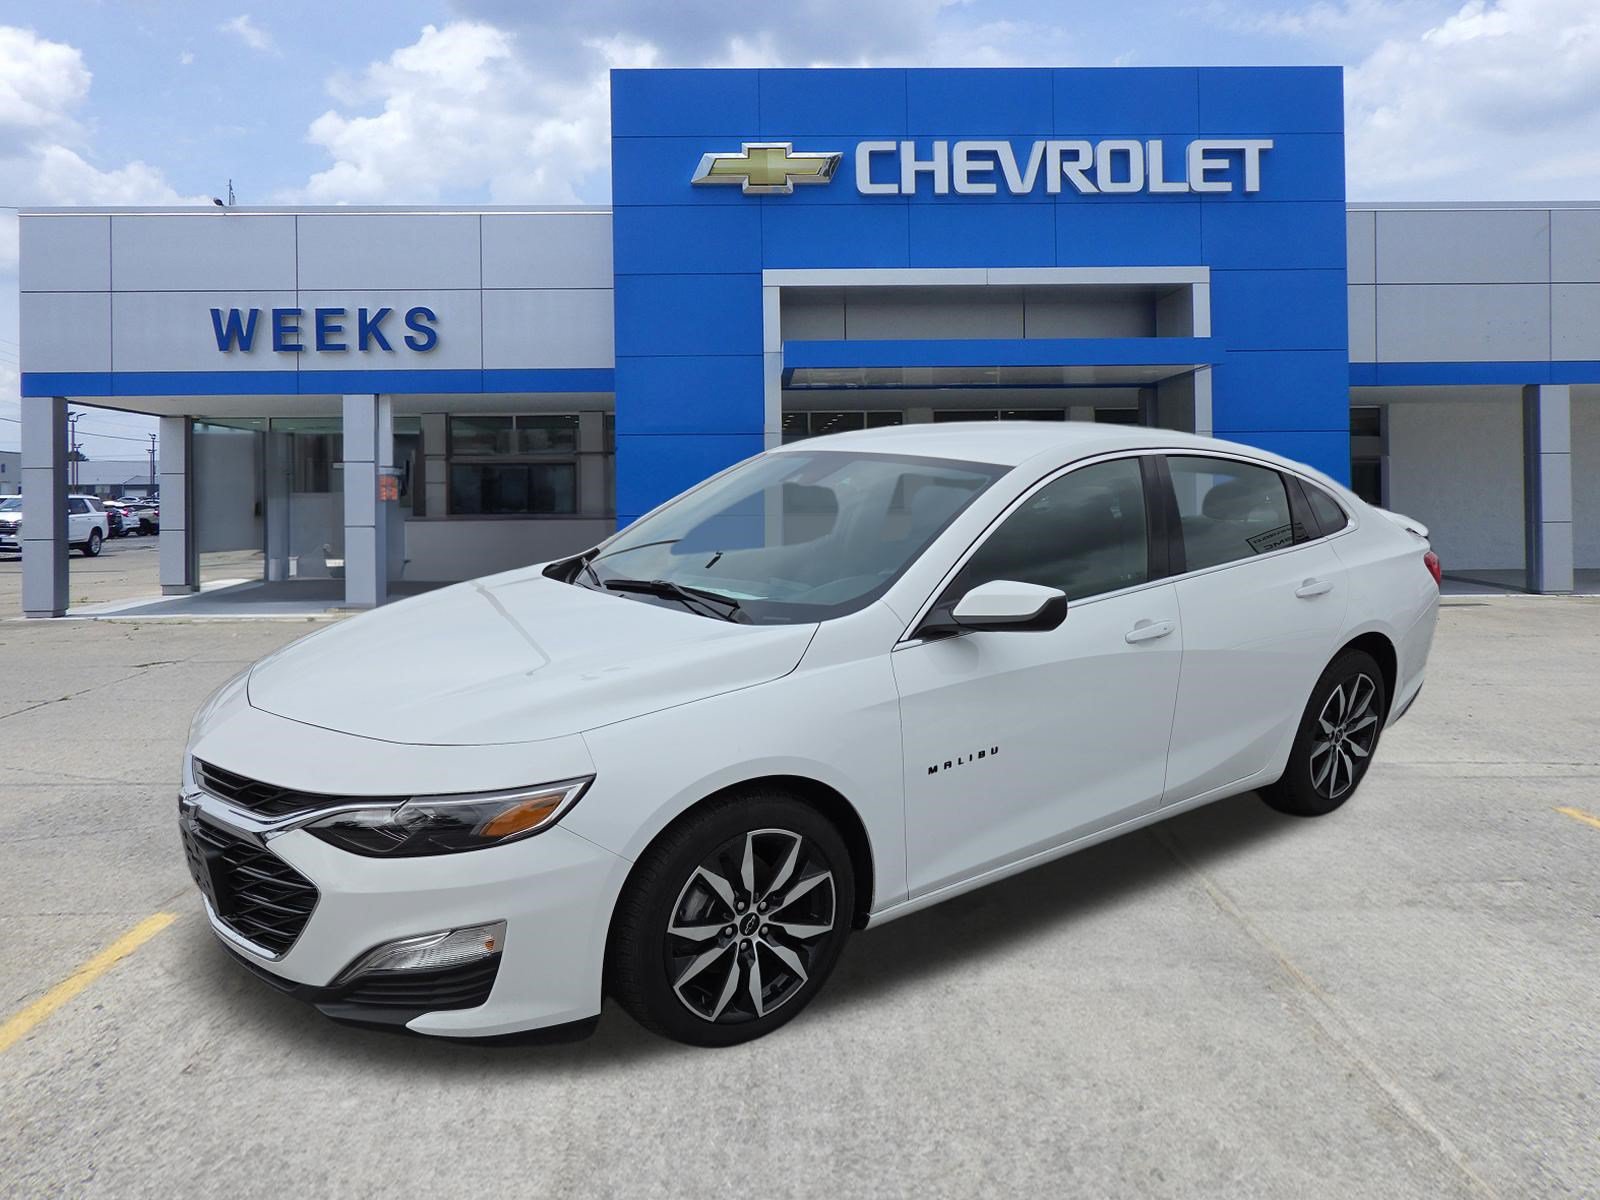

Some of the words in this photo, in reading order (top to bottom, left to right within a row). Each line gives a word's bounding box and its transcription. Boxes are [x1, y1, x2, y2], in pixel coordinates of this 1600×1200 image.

[855, 139, 1274, 195] CHEVROLET
[210, 306, 439, 354] WEEKS
[928, 746, 999, 775] MALIBU
